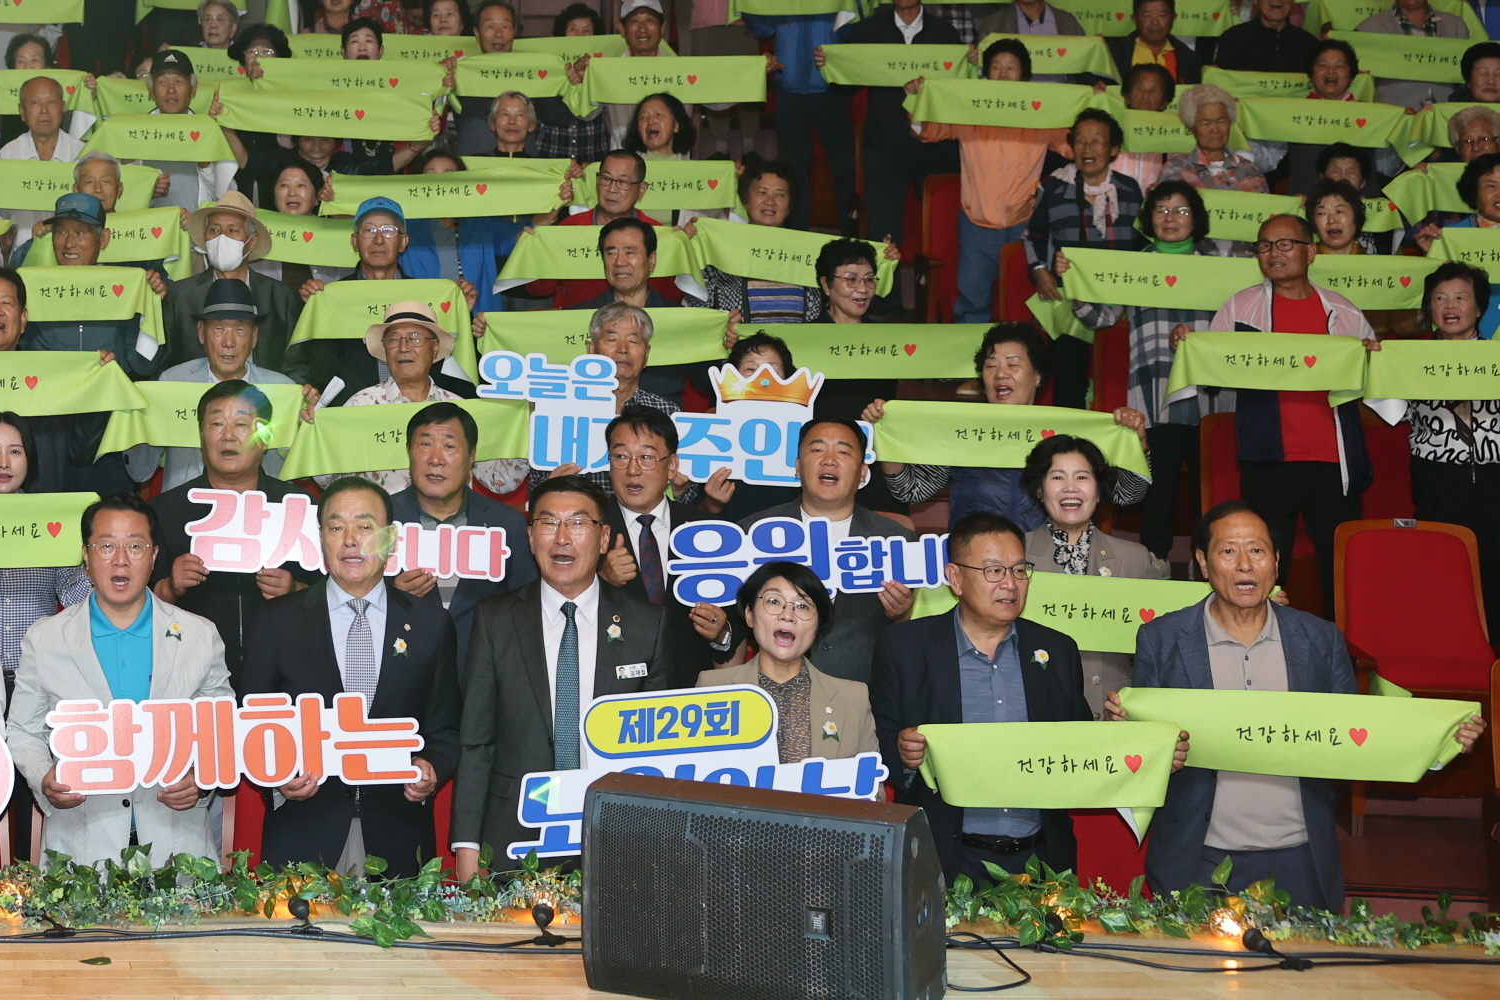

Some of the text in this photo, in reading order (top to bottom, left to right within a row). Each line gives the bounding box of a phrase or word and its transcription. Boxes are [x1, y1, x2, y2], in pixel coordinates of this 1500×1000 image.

[887, 61, 940, 71] 건강하세요
[1404, 53, 1459, 66] 건강하세요
[480, 69, 533, 79] 건강하세요
[628, 74, 683, 86] 건강하세요
[331, 77, 385, 88] 건강하세요
[971, 98, 1027, 111] 건강하세요
[293, 107, 351, 120] 건강하세요
[1292, 115, 1351, 128] 건강하세요
[128, 129, 185, 141] 건강하세요
[408, 185, 471, 198] 건강하세요
[112, 228, 147, 240] 하세요
[751, 248, 812, 266] 건강하세요
[1094, 272, 1160, 287] 건강하세요
[1327, 275, 1395, 288] 건강하세요
[40, 284, 107, 298] 건강하세요
[829, 343, 899, 357] 건강하세요
[1225, 353, 1299, 368] 건강하세요
[1423, 362, 1500, 377] 건강하세요
[478, 355, 614, 400] 오늘은
[955, 427, 1035, 443] 건강하세요
[670, 519, 949, 603] 응원합니
[1042, 603, 1132, 623] 건강하세요
[618, 700, 740, 744] 제29회
[1236, 724, 1342, 746] 건강하세요
[48, 693, 424, 794] 함께하는
[1017, 754, 1118, 775] 건강하세요
